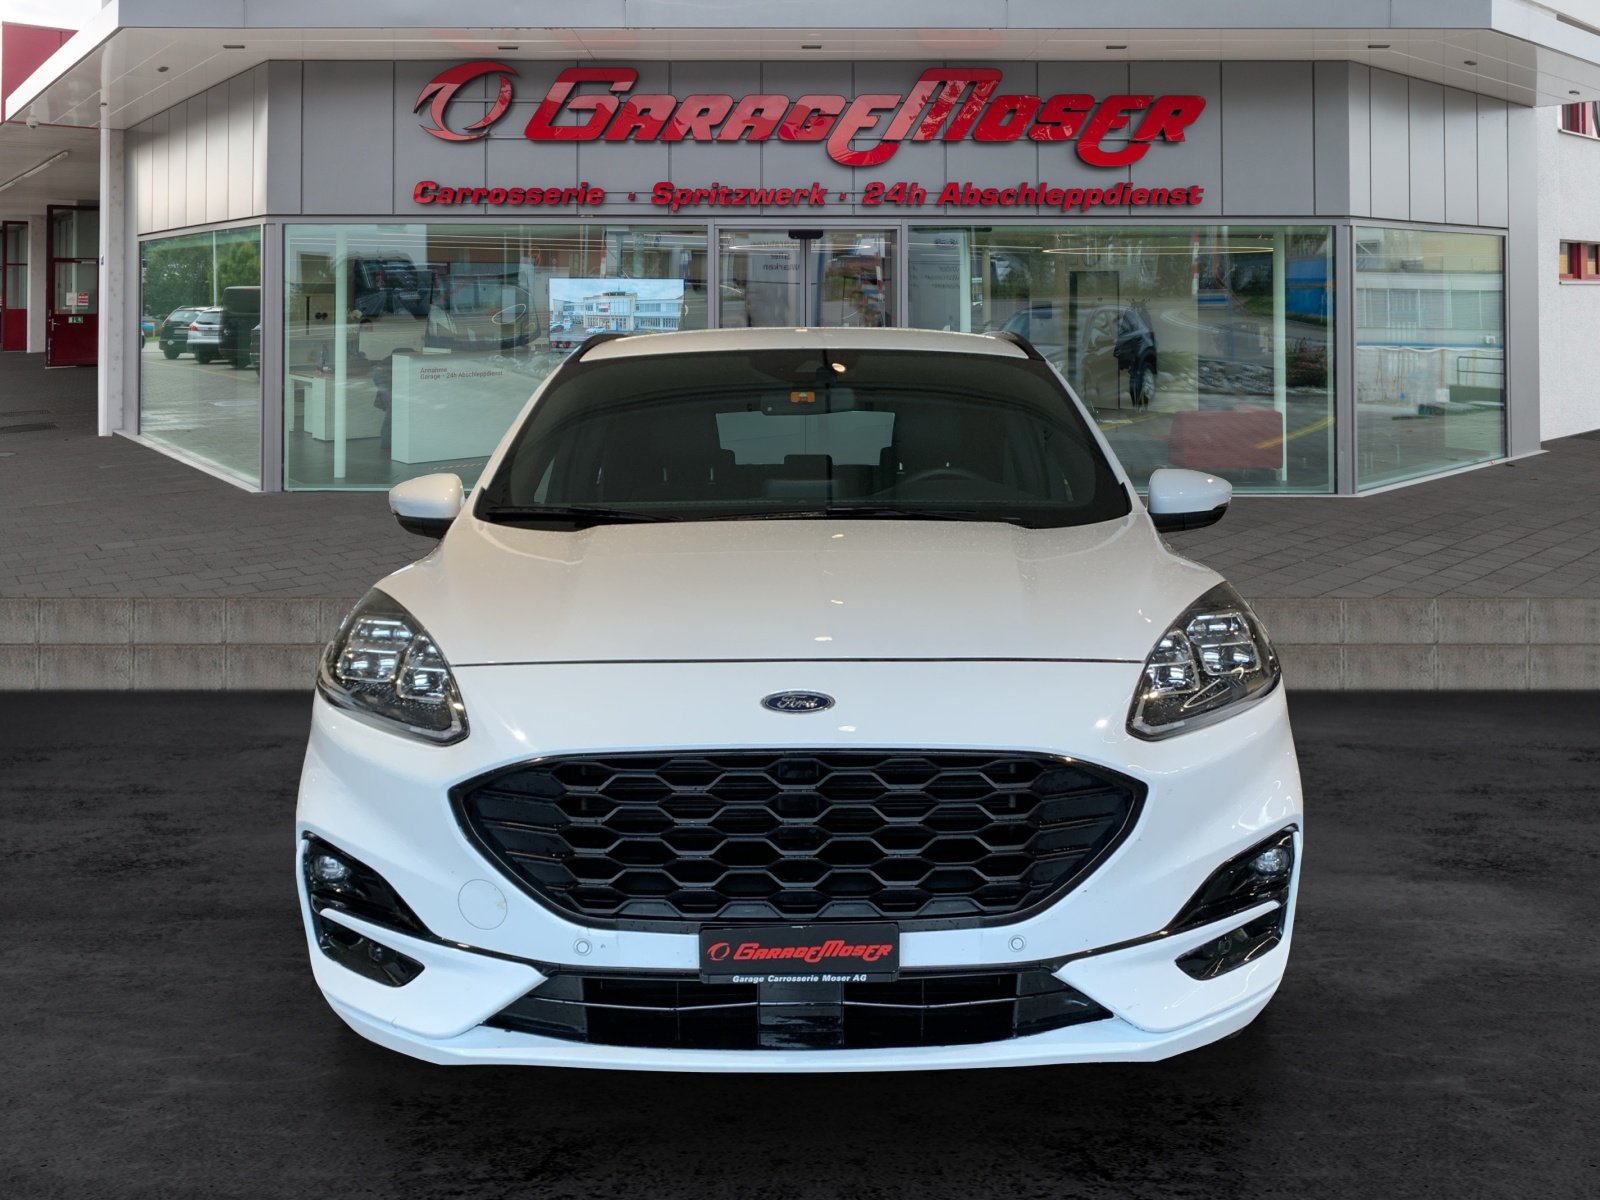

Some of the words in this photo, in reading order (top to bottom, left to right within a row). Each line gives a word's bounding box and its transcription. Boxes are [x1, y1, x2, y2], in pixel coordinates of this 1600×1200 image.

[413, 180, 605, 206] Carrosserie
[651, 181, 826, 211] Spritzwerk
[862, 181, 927, 206] 24h
[937, 182, 1205, 212] Abschleppdienst
[777, 695, 818, 709] Ford
[732, 975, 765, 983] Garage
